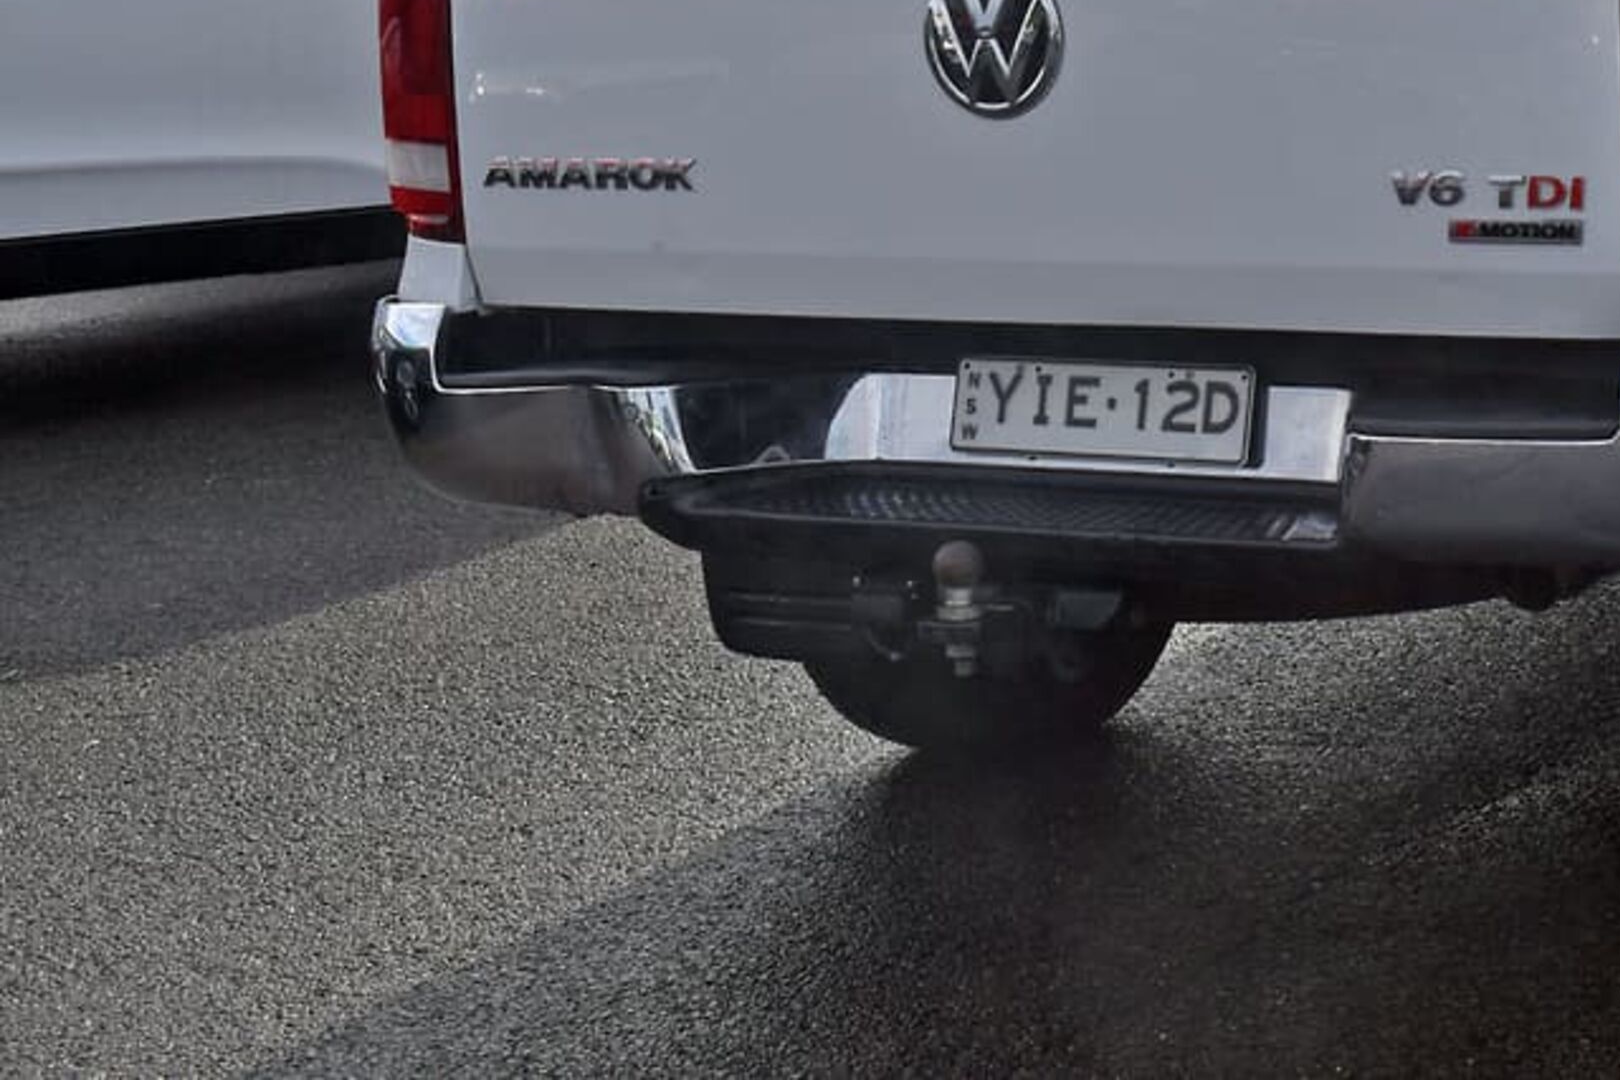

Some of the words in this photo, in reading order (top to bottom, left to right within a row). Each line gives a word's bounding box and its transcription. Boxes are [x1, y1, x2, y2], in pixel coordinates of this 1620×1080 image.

[484, 156, 696, 191] AMAROK
[1392, 170, 1465, 207] V6
[1489, 175, 1585, 210] TDI
